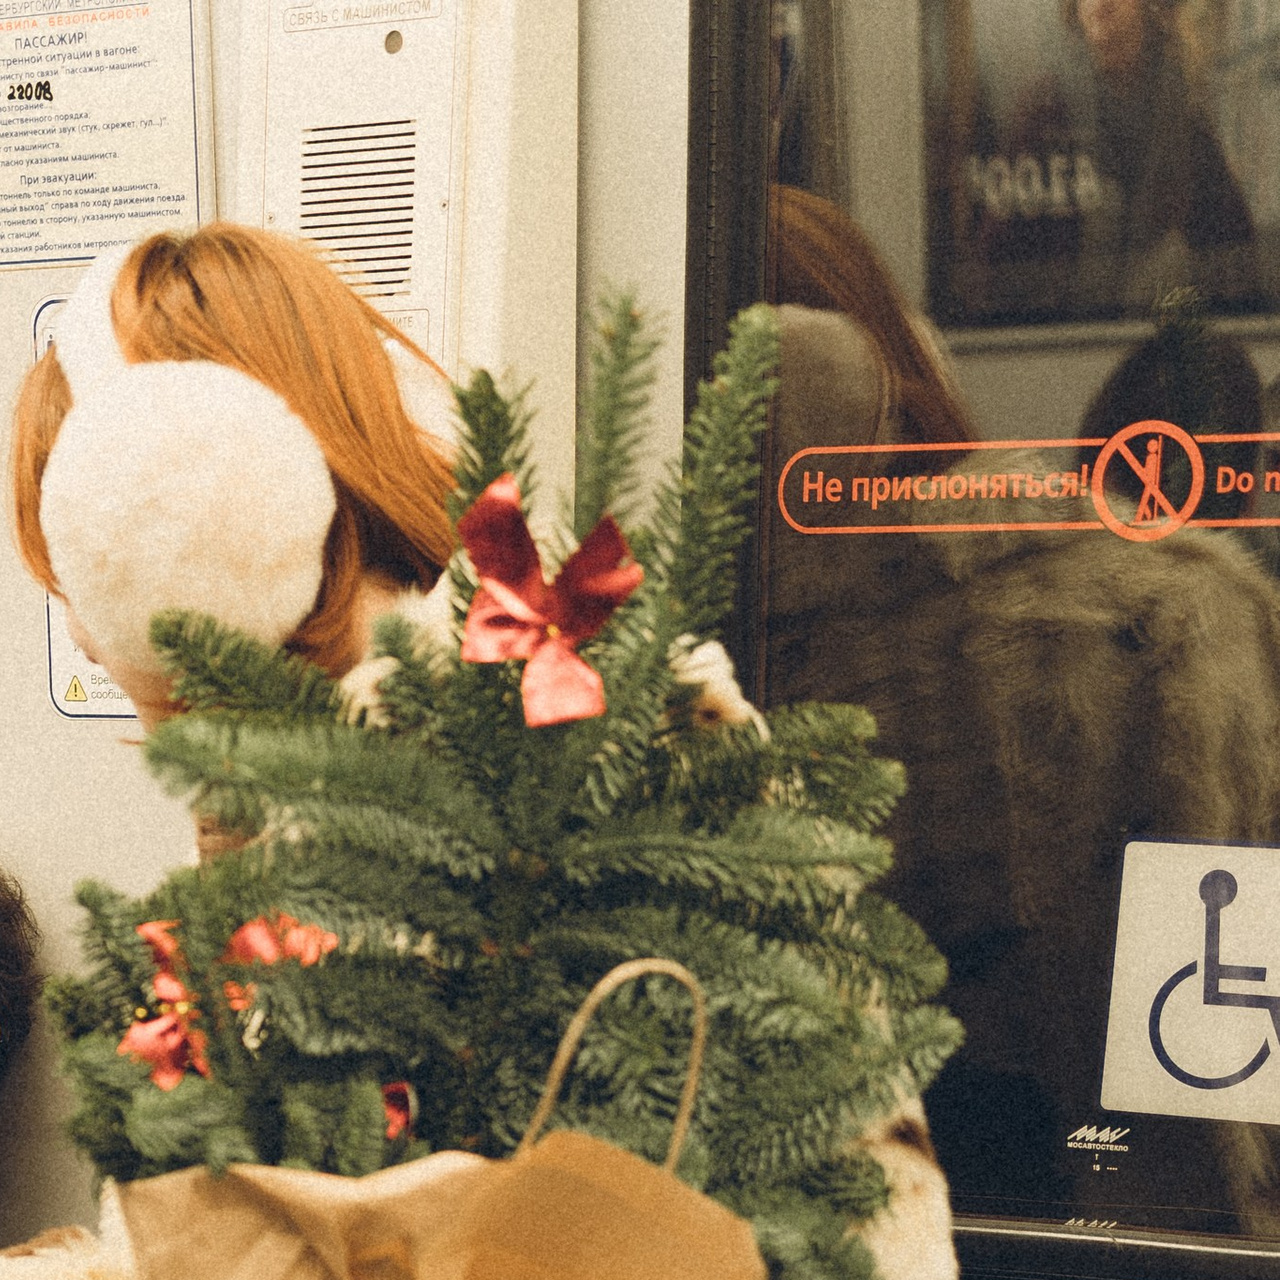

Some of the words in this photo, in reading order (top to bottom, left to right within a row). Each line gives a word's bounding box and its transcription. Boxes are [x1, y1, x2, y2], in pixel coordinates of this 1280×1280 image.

[48, 7, 150, 27] БЕЗОПАСНОСТИ
[290, 11, 328, 26] СВЯЗЬ
[331, 9, 340, 22] С
[343, 0, 432, 21] МАШИНИСТОМ
[15, 31, 88, 50] ПАССАЖИР!
[45, 49, 92, 64] ситуации
[96, 50, 102, 58] в
[25, 71, 35, 81] по
[37, 69, 58, 78] связи
[0, 126, 56, 139] механический
[59, 126, 75, 136] звук
[4, 145, 13, 153] от
[26, 154, 69, 167] указаниям
[20, 174, 39, 187] При
[41, 171, 97, 185] эвакуации:
[0, 190, 32, 201] тоннель
[34, 187, 61, 198] только
[63, 187, 73, 196] по
[75, 184, 110, 195] команде
[51, 200, 78, 212] справа
[81, 199, 90, 208] по
[92, 197, 111, 209] ходу
[114, 195, 155, 207] движения
[4, 216, 38, 227] тоннелю
[82, 210, 126, 222] указанную
[35, 241, 81, 253] работников
[803, 471, 842, 502] Не
[852, 463, 1088, 510] прислоняться!
[1217, 466, 1254, 493] Do
[91, 689, 128, 701] сообще
